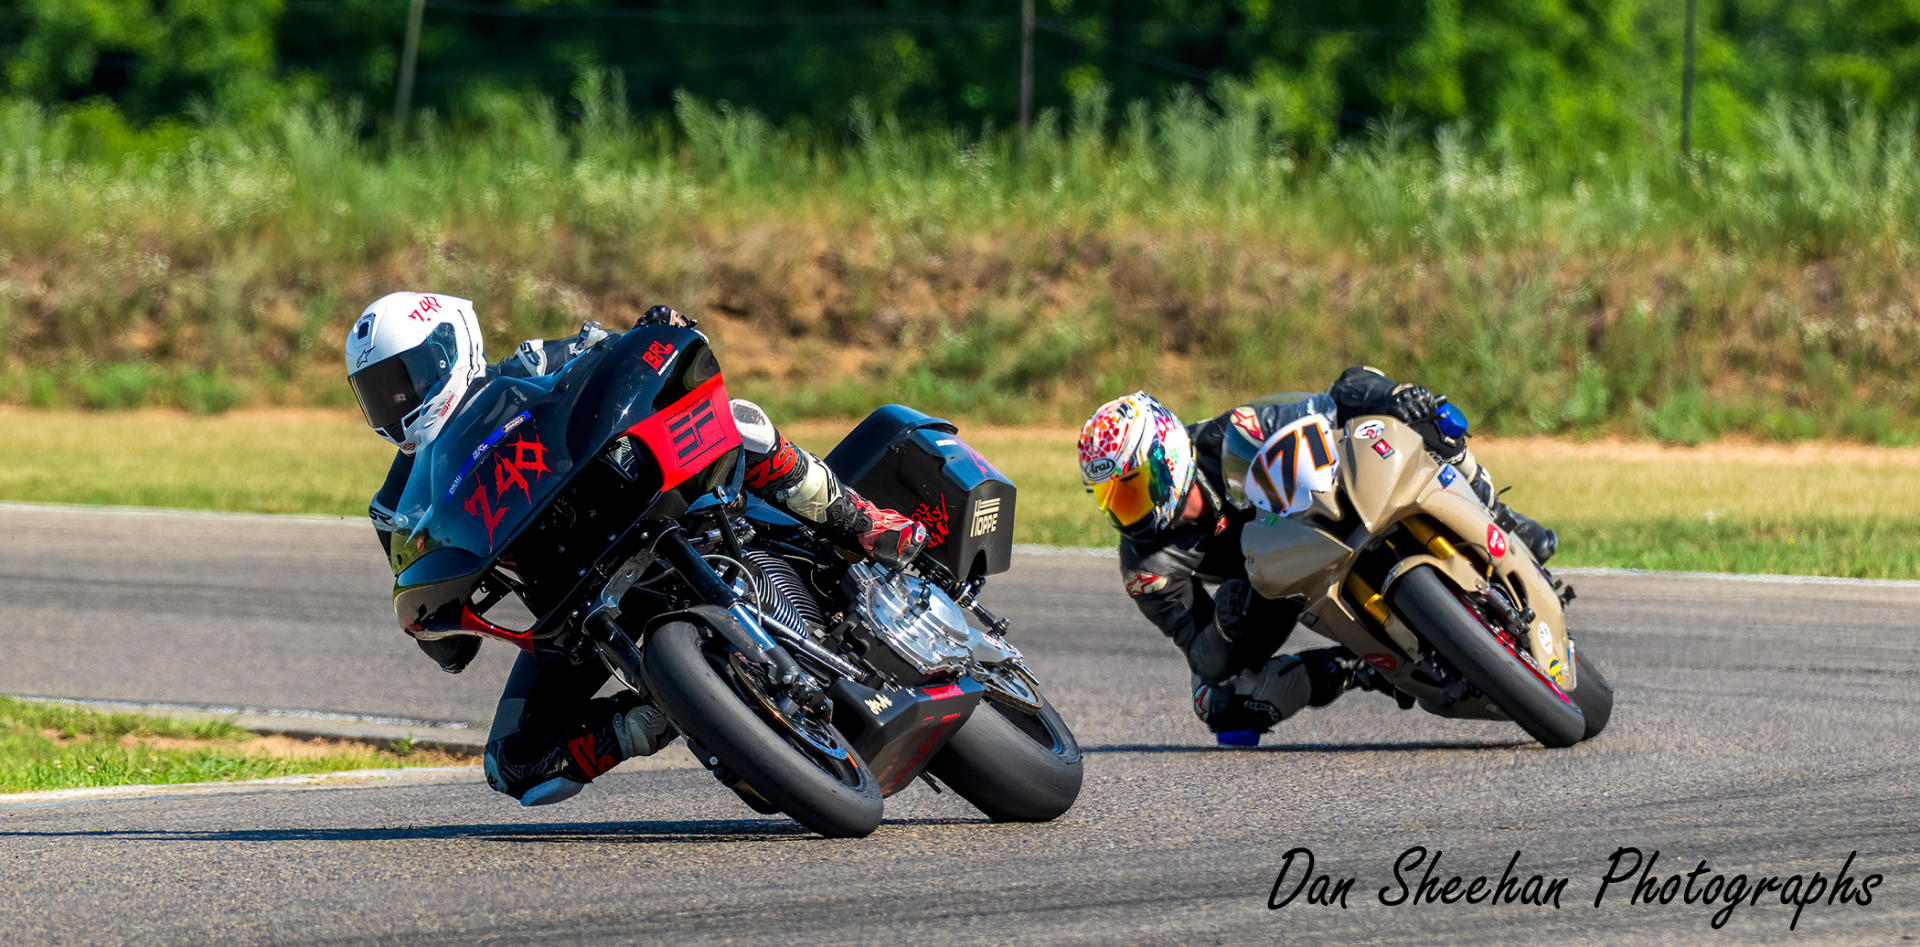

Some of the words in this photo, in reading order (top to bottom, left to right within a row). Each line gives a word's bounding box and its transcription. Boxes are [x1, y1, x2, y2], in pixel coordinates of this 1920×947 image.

[641, 339, 674, 371] BRL
[1090, 461, 1110, 475] Arai
[1251, 421, 1334, 514] 171
[911, 503, 931, 522] ou
[922, 505, 945, 528] My
[970, 497, 1001, 538] HOPPE
